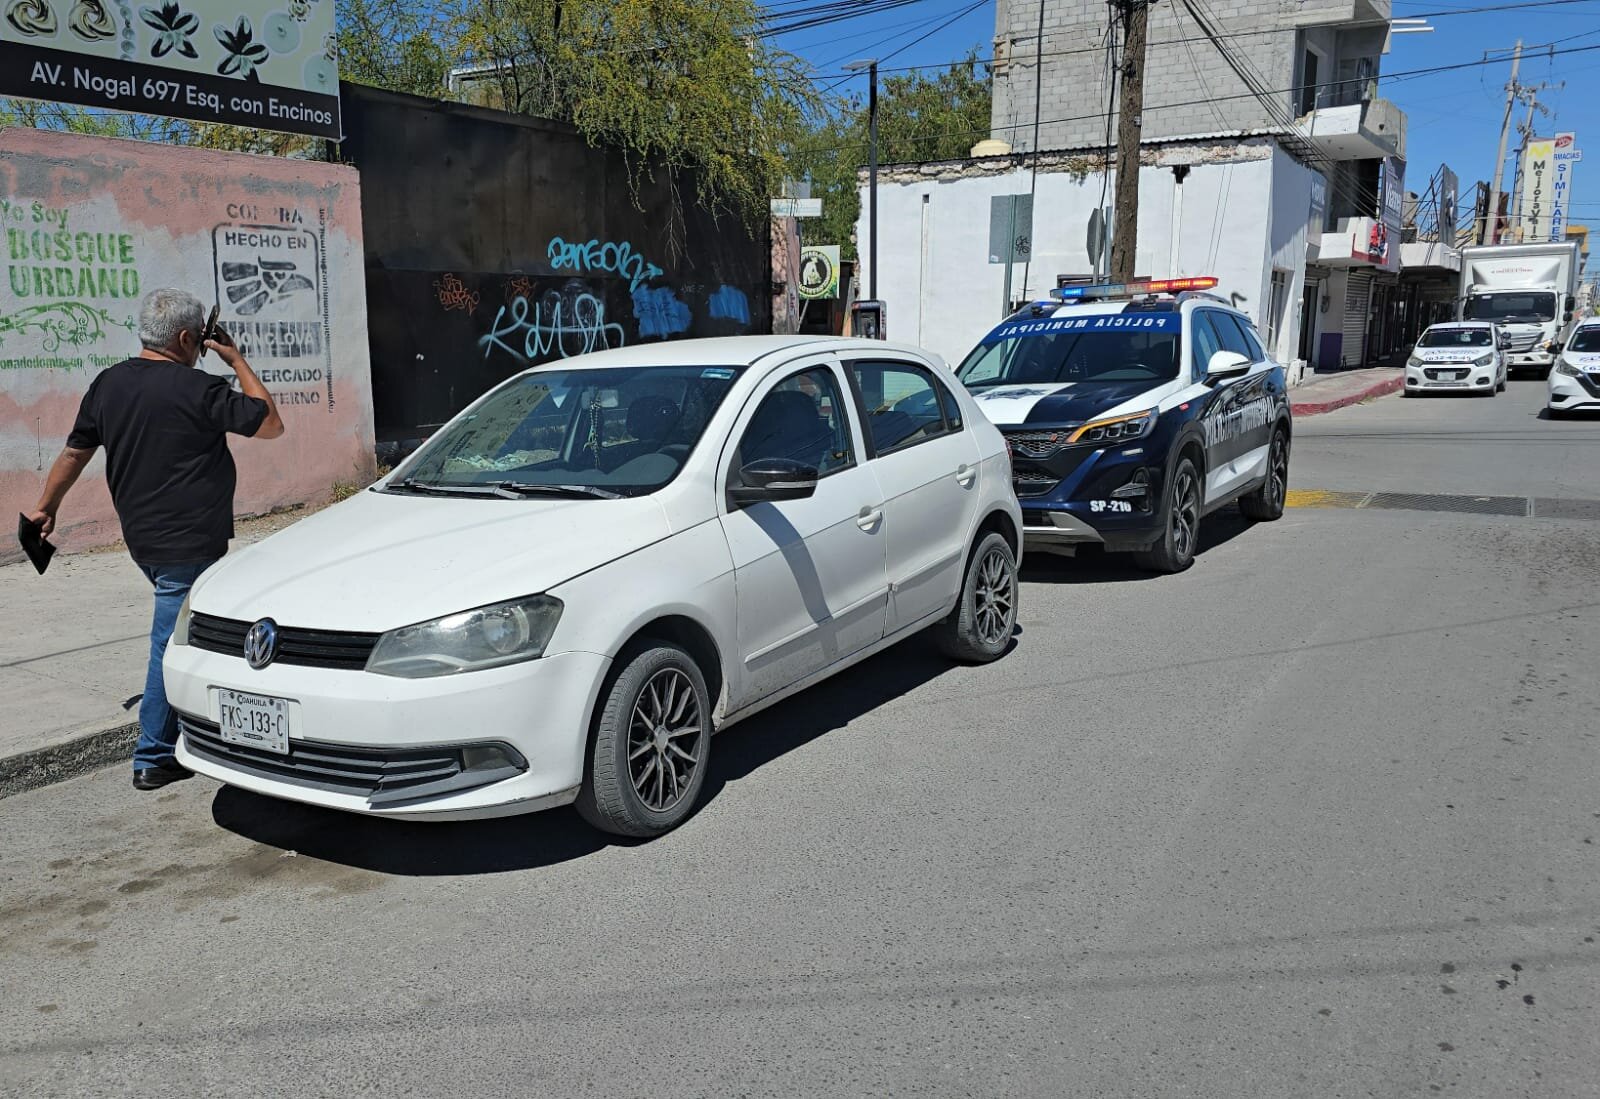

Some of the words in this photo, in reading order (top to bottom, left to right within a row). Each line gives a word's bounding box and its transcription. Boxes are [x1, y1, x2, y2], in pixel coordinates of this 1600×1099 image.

[30, 60, 66, 87] AV.
[73, 67, 136, 99] Nogal
[142, 78, 181, 103] 697
[185, 86, 225, 114] Esq.
[230, 96, 263, 116] con
[268, 97, 332, 125] Encinos
[8, 228, 135, 265] BOSQUE
[225, 231, 282, 248] HECHO
[287, 236, 308, 249] EN
[9, 265, 139, 297] URBANO
[271, 391, 321, 405] TERNO
[221, 703, 284, 737] FKS-133-C
